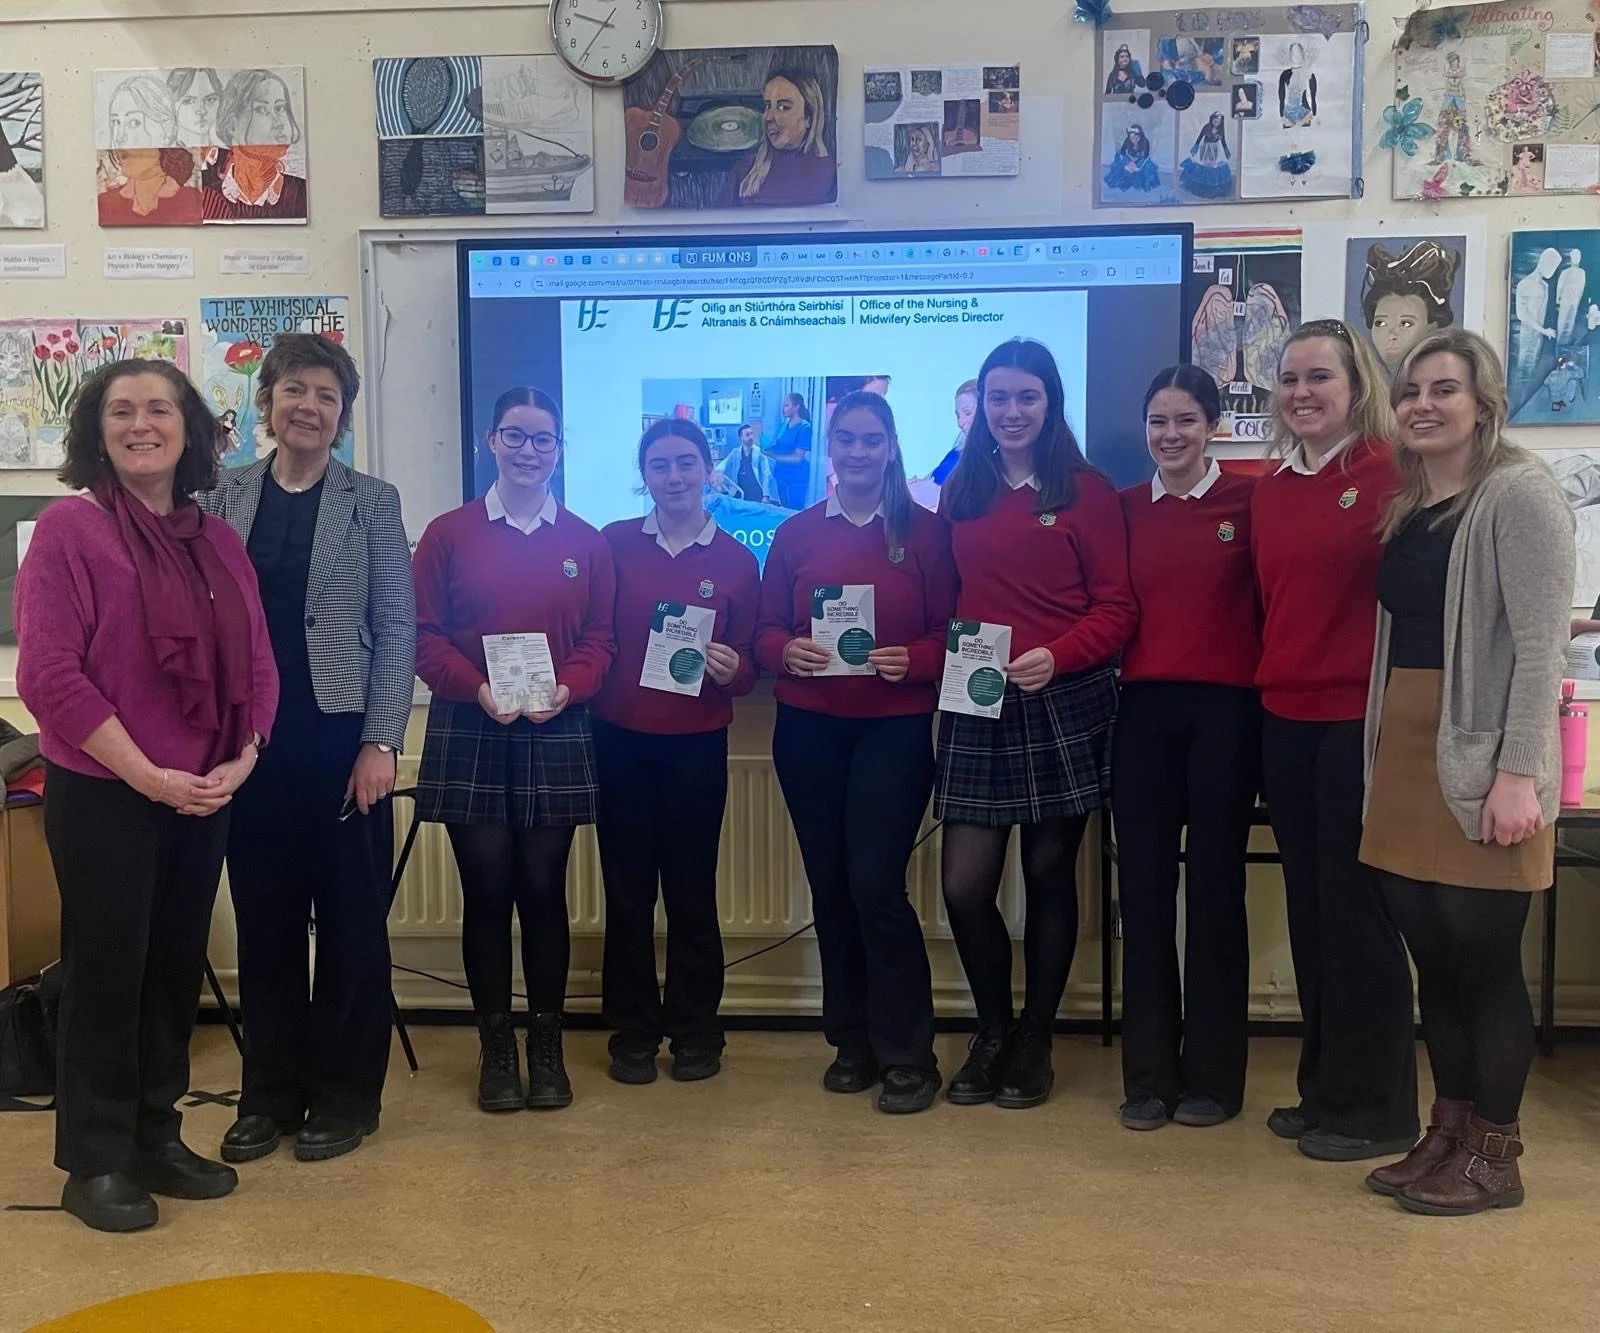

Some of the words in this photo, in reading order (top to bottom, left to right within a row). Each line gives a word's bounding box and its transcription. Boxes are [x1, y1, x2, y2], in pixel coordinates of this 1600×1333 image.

[635, 0, 641, 9] 2
[565, 18, 571, 28] 9
[641, 20, 647, 30] 3
[570, 38, 576, 48] 8
[635, 40, 641, 49] 4
[584, 53, 590, 62] 7
[621, 54, 627, 64] 5
[602, 59, 608, 69] 6
[702, 252, 726, 263] FUM
[728, 251, 751, 263] QN3
[209, 300, 246, 317] THE
[249, 298, 338, 316] WHIMSICAL
[701, 302, 726, 314] Oifig
[729, 304, 742, 313] an
[744, 300, 796, 313] Stiúrthóra
[798, 299, 844, 312] Seirbhísí
[859, 299, 891, 310] Office
[893, 298, 905, 309] of
[907, 298, 924, 309] the
[927, 297, 968, 310] Nursing
[970, 297, 979, 308] &
[205, 317, 278, 333] WONDERS
[283, 316, 304, 333] OF
[306, 315, 345, 333] THE
[701, 316, 748, 327] Altranais
[749, 316, 758, 327] &
[760, 314, 846, 327] Cnáimhseachais
[859, 313, 911, 326] Midwifery
[913, 312, 959, 324] Services
[961, 311, 1005, 323] Director
[245, 333, 272, 349] WE
[40, 408, 69, 426] Won
[1234, 420, 1273, 440] COLO
[733, 529, 775, 547] OOS
[665, 627, 697, 638] INCREDIBLE
[667, 622, 698, 633] SOMETHING
[961, 641, 995, 651] SOMETHING
[961, 647, 995, 656] INCREDIBLE
